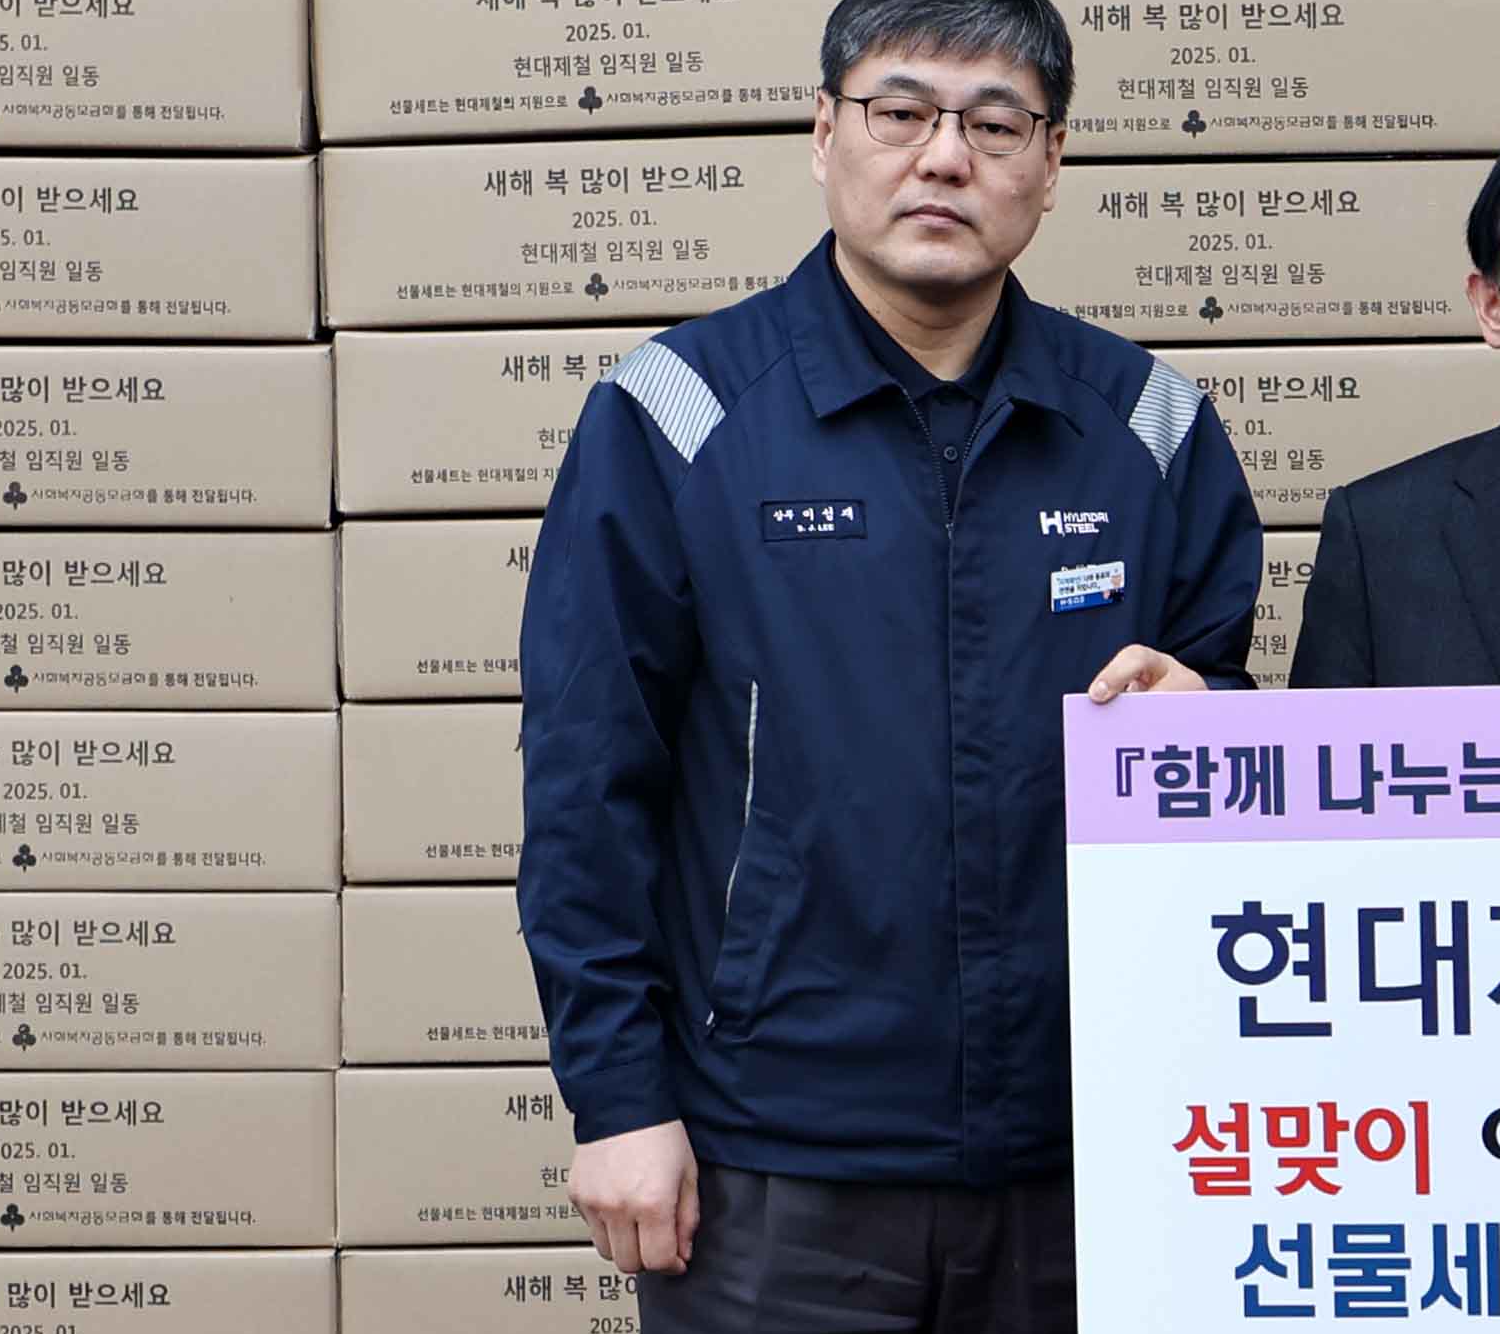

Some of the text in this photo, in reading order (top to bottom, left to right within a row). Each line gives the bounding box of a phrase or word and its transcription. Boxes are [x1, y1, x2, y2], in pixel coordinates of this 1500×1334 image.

[37, 185, 139, 214] 받으세요
[23, 229, 51, 247] 01.
[0, 259, 56, 283] 임직원
[65, 260, 103, 283] 일동
[136, 300, 161, 315] 통해
[166, 299, 231, 315] 전달됩니다.
[1063, 512, 1109, 523] HYUNDAI
[1065, 523, 1100, 534] STEEL
[1172, 1101, 1430, 1196] 설맞이
